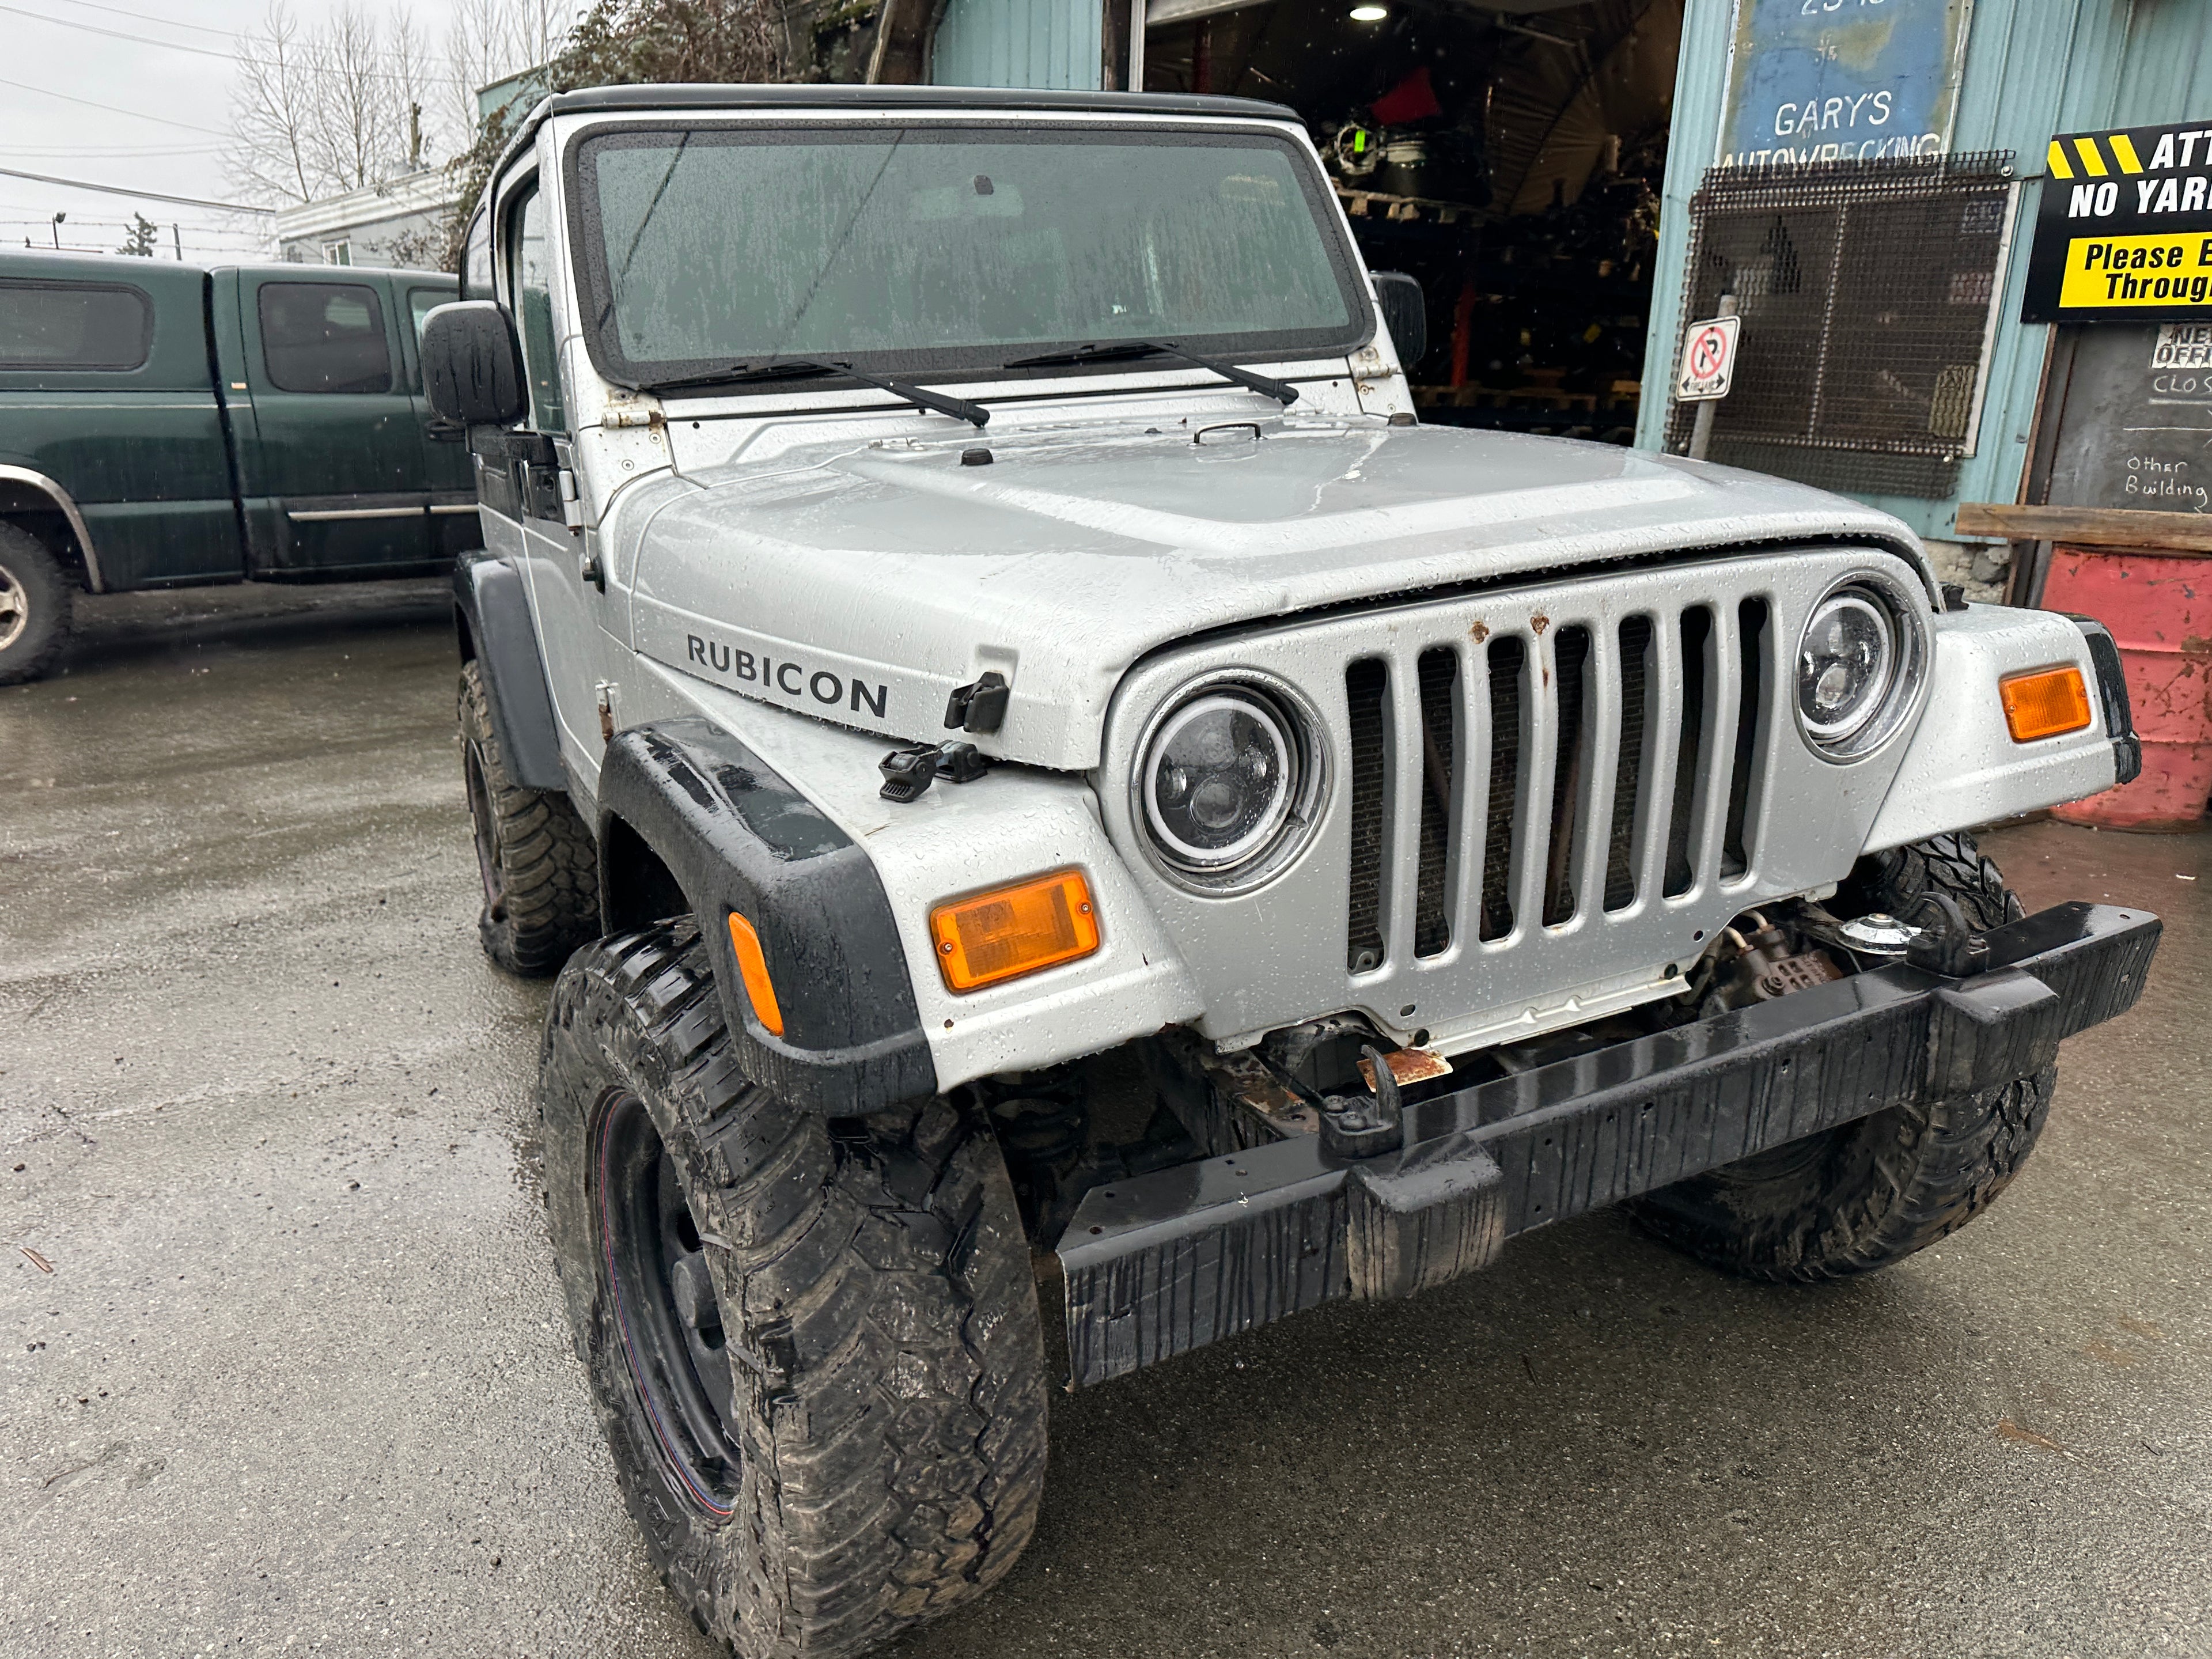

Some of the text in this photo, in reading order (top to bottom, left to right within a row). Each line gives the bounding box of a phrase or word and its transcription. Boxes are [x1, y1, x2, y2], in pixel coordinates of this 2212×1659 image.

[1775, 90, 1892, 137] GARY'S
[2068, 176, 2212, 218] NO YAR
[2084, 243, 2184, 270] Please
[2105, 272, 2212, 302] Throug
[2126, 475, 2208, 508] Building
[687, 634, 888, 718] RUBICON
